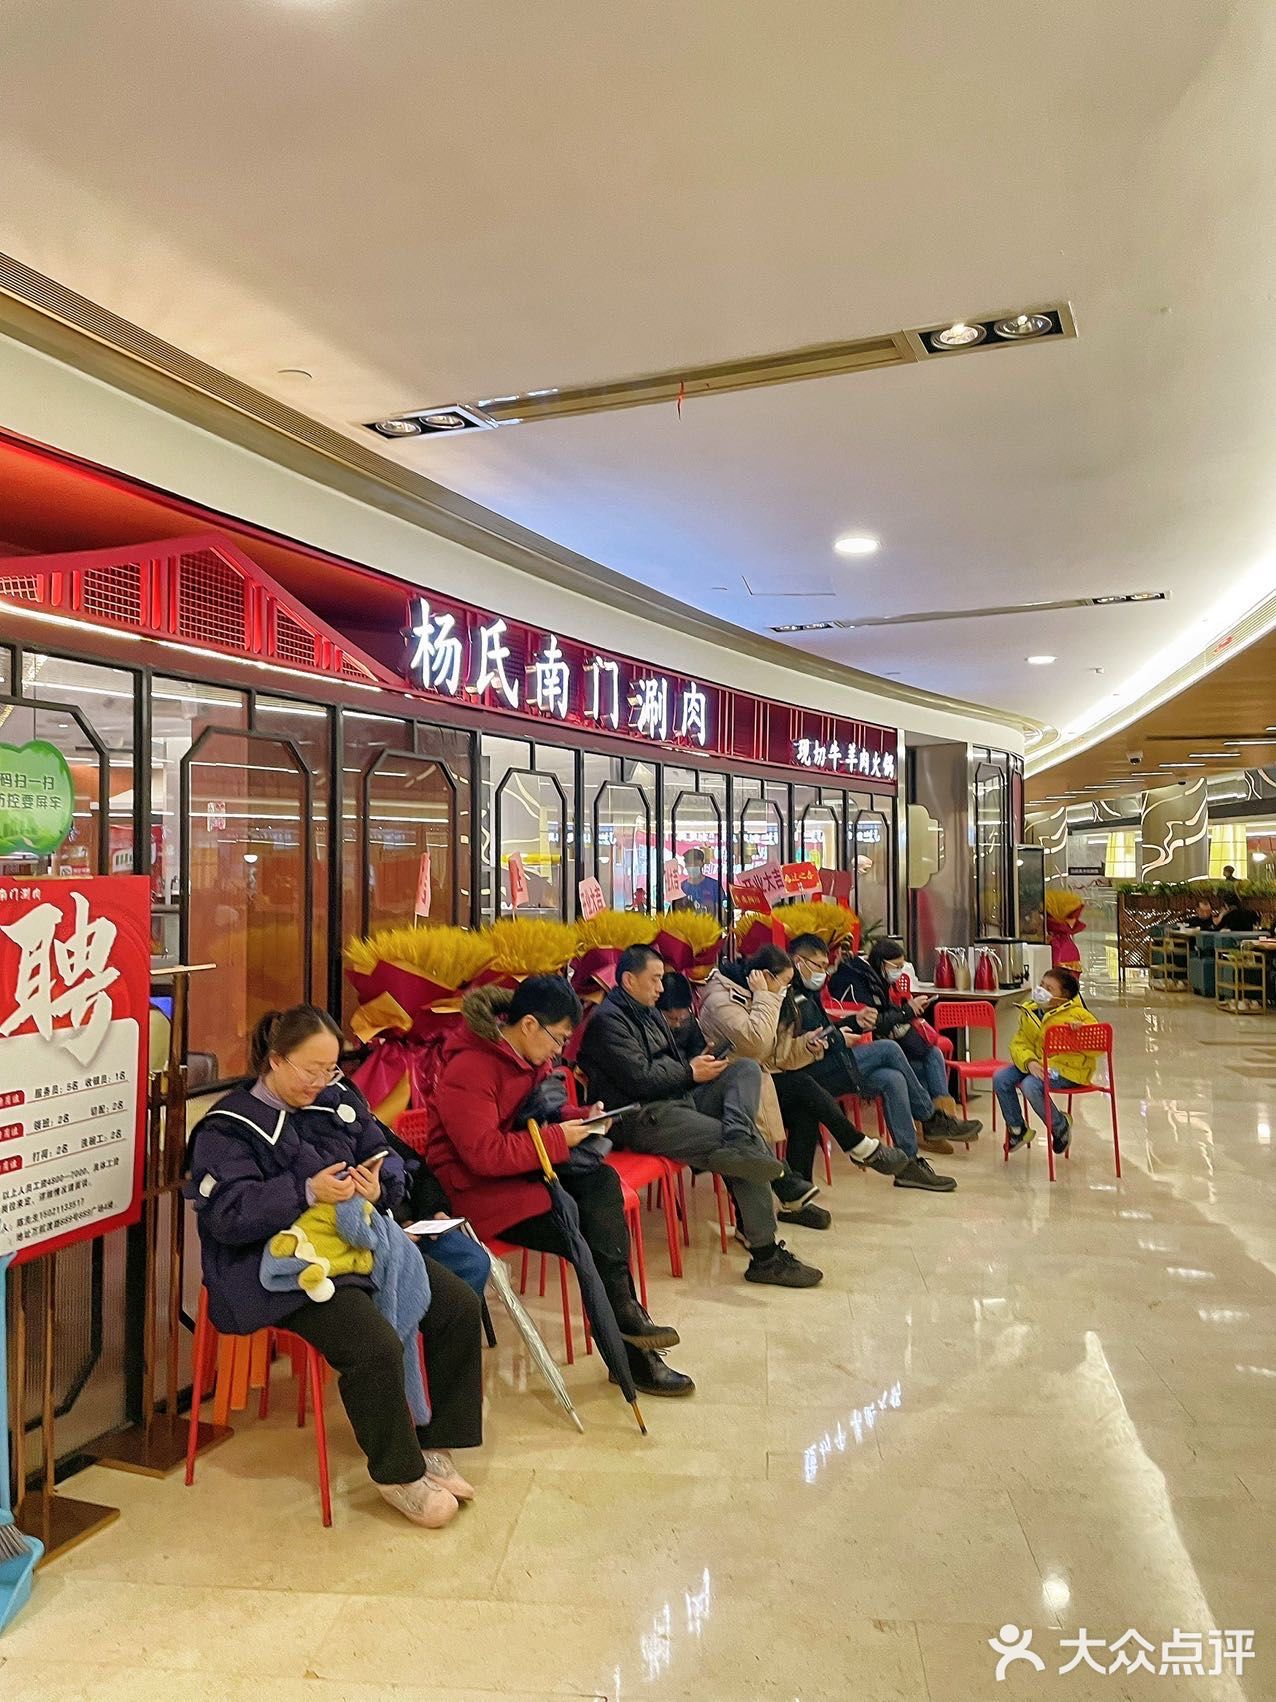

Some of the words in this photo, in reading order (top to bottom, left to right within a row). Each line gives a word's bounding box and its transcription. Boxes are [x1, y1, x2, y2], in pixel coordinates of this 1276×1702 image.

[410, 597, 707, 746] 杨氏南门涮肉
[796, 738, 895, 780] 现切牛羊肉火锅
[0, 891, 121, 1067] 聘
